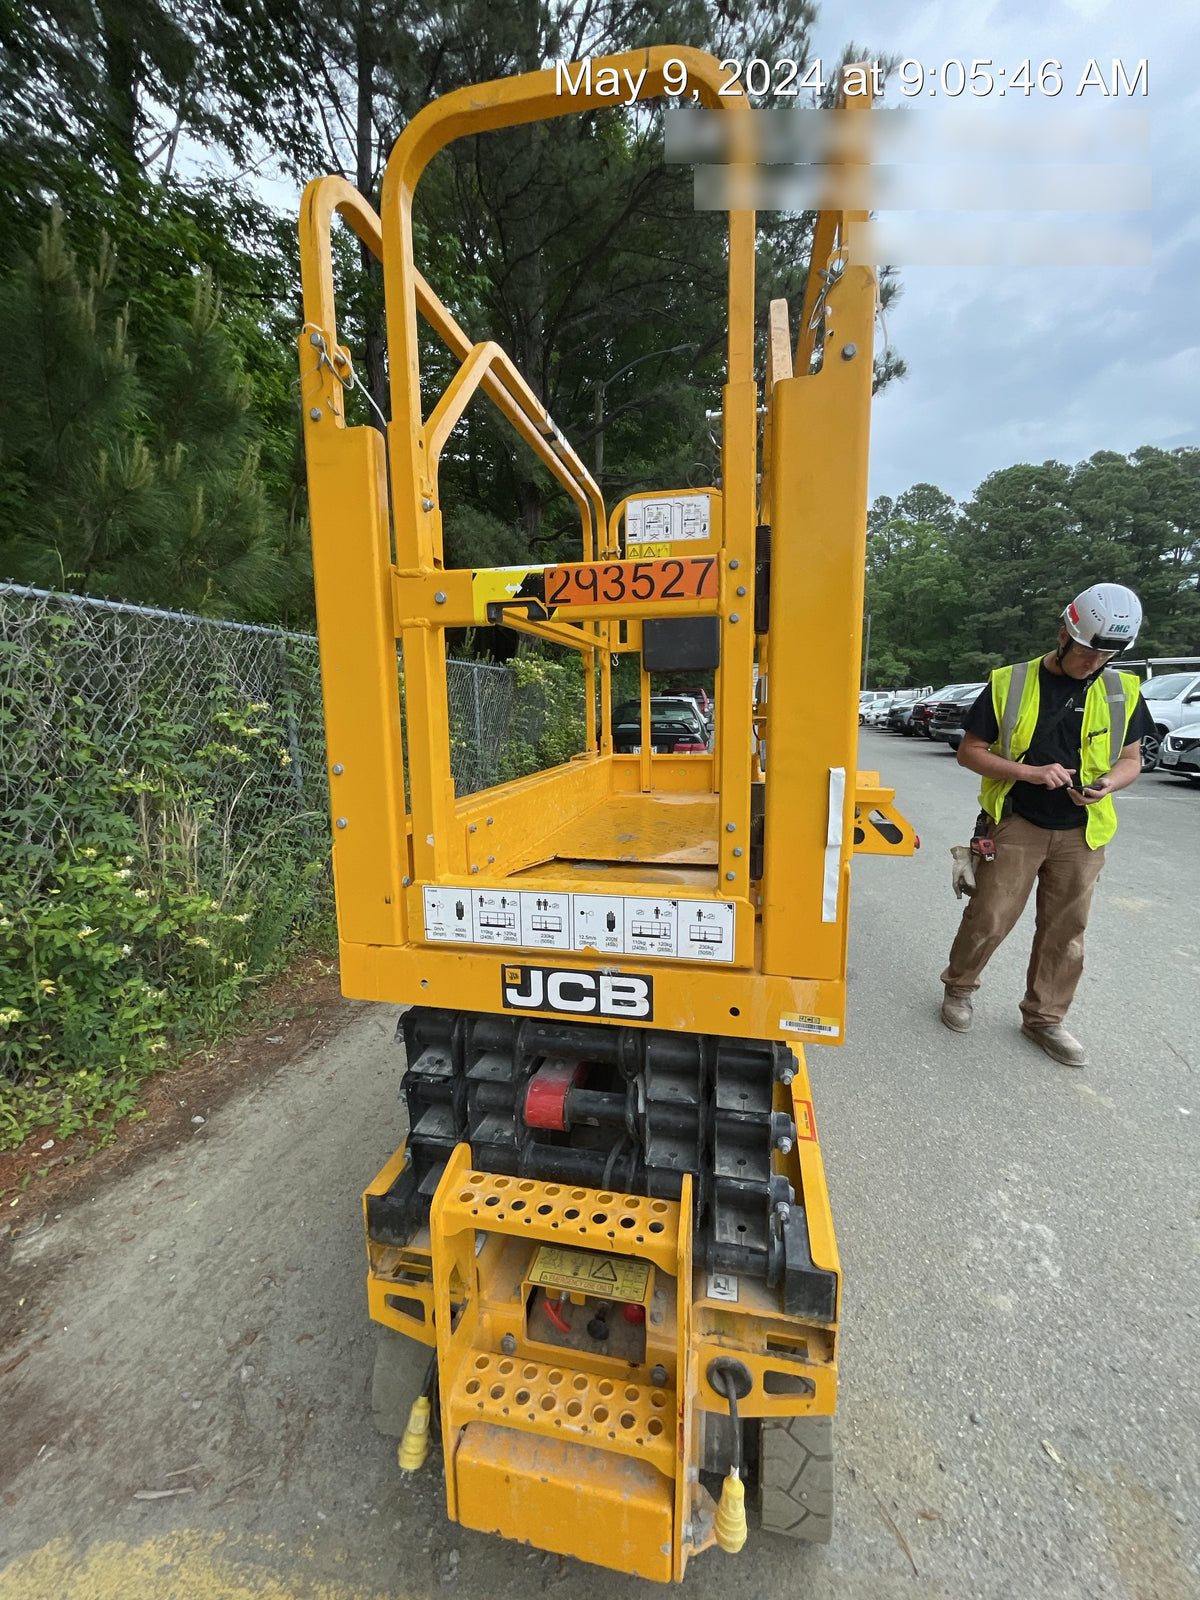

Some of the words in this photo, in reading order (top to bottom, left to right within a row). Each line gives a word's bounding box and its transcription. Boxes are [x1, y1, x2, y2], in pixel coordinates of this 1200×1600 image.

[549, 557, 716, 604] 293527
[1108, 623, 1131, 633] EMC
[505, 970, 650, 1017] JCB
